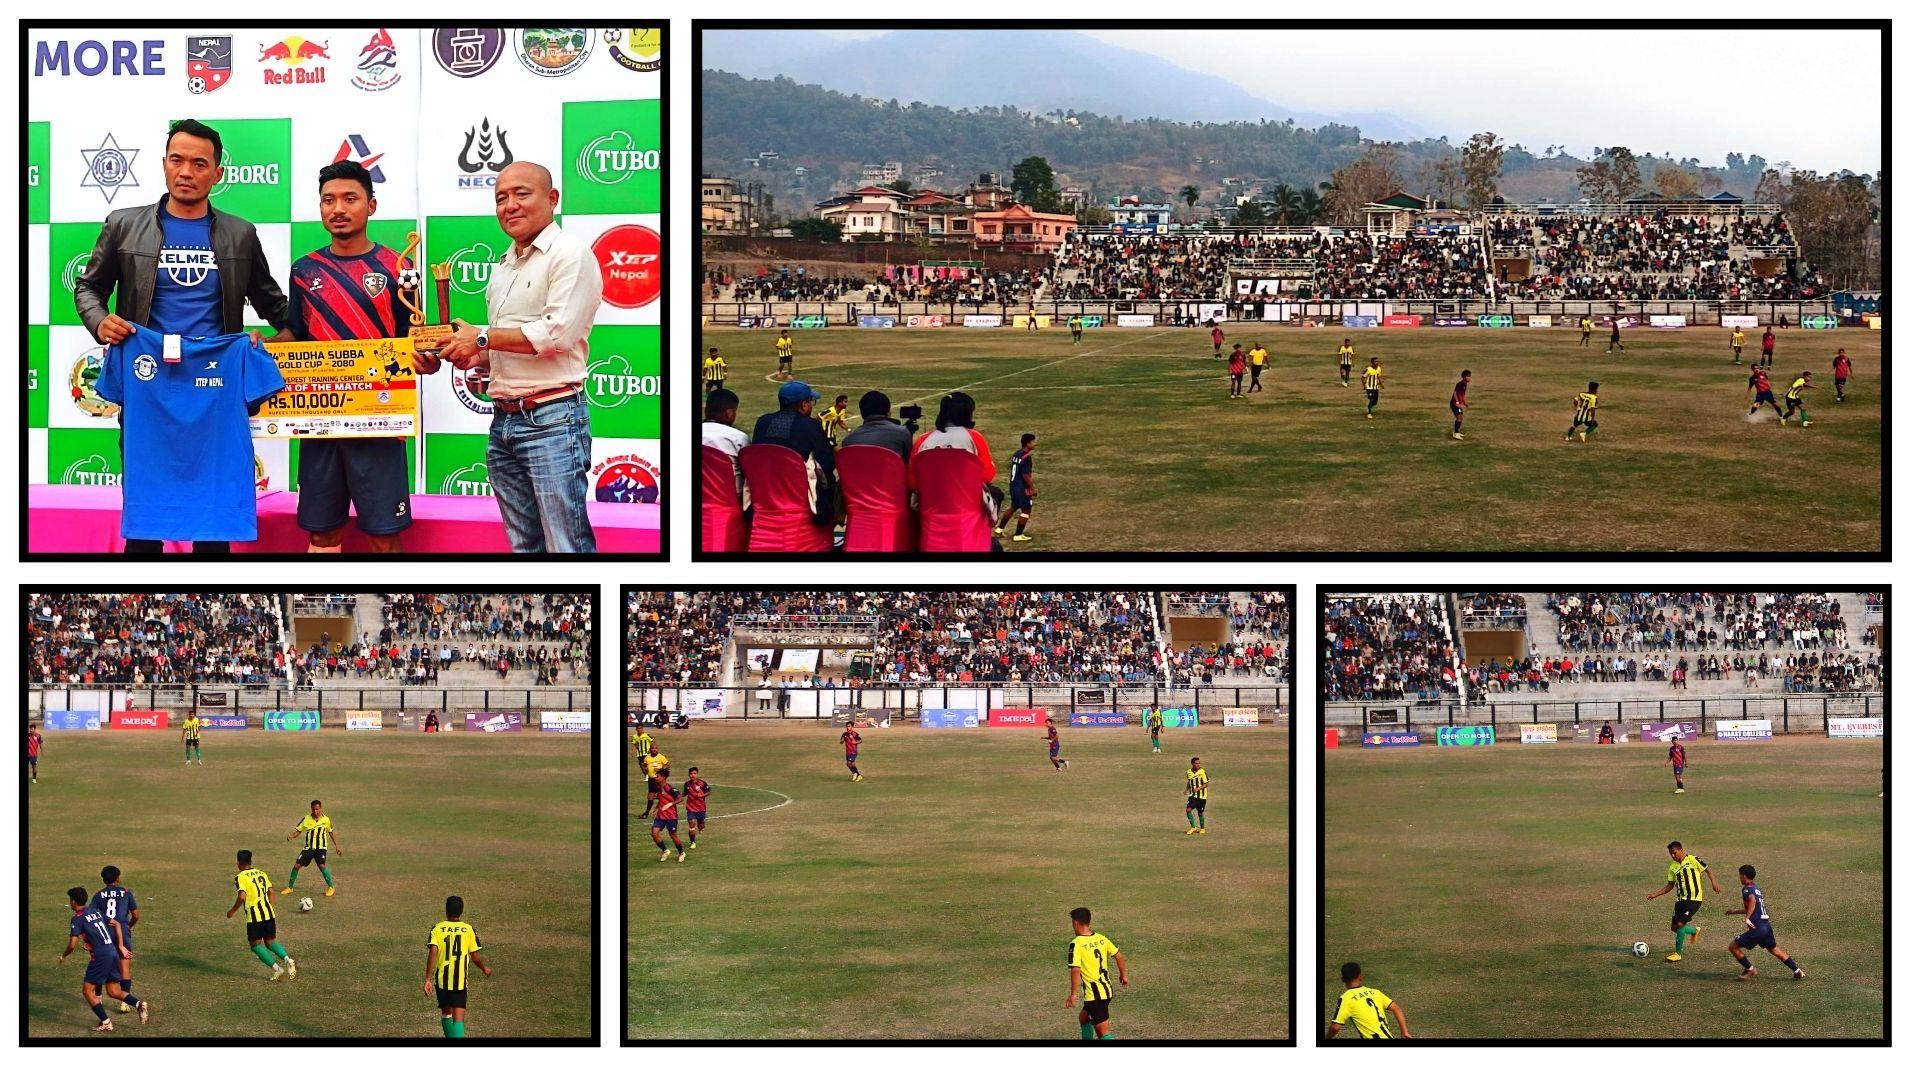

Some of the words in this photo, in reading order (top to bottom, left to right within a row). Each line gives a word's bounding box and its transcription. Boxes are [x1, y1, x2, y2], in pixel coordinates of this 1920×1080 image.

[35, 40, 165, 76] MORE
[521, 53, 535, 69] Dharan
[535, 60, 581, 75] Sub-Metropolitan
[617, 53, 656, 69] FOOTBALL
[264, 69, 293, 84] Red
[296, 67, 325, 84] Bull
[595, 150, 660, 172] TUBO
[610, 269, 648, 280] Nepal
[288, 351, 324, 360] BUDHA
[328, 350, 364, 359] SUBBA
[332, 360, 355, 368] 2080
[195, 378, 208, 387] XTEP
[268, 392, 354, 409] Rs.10,000/-
[101, 890, 125, 898] N.R.T
[106, 898, 117, 919] 8
[94, 921, 112, 944] 11
[444, 935, 462, 961] 14
[1082, 940, 1105, 950] TAFC
[1352, 990, 1375, 1000] TAFC
